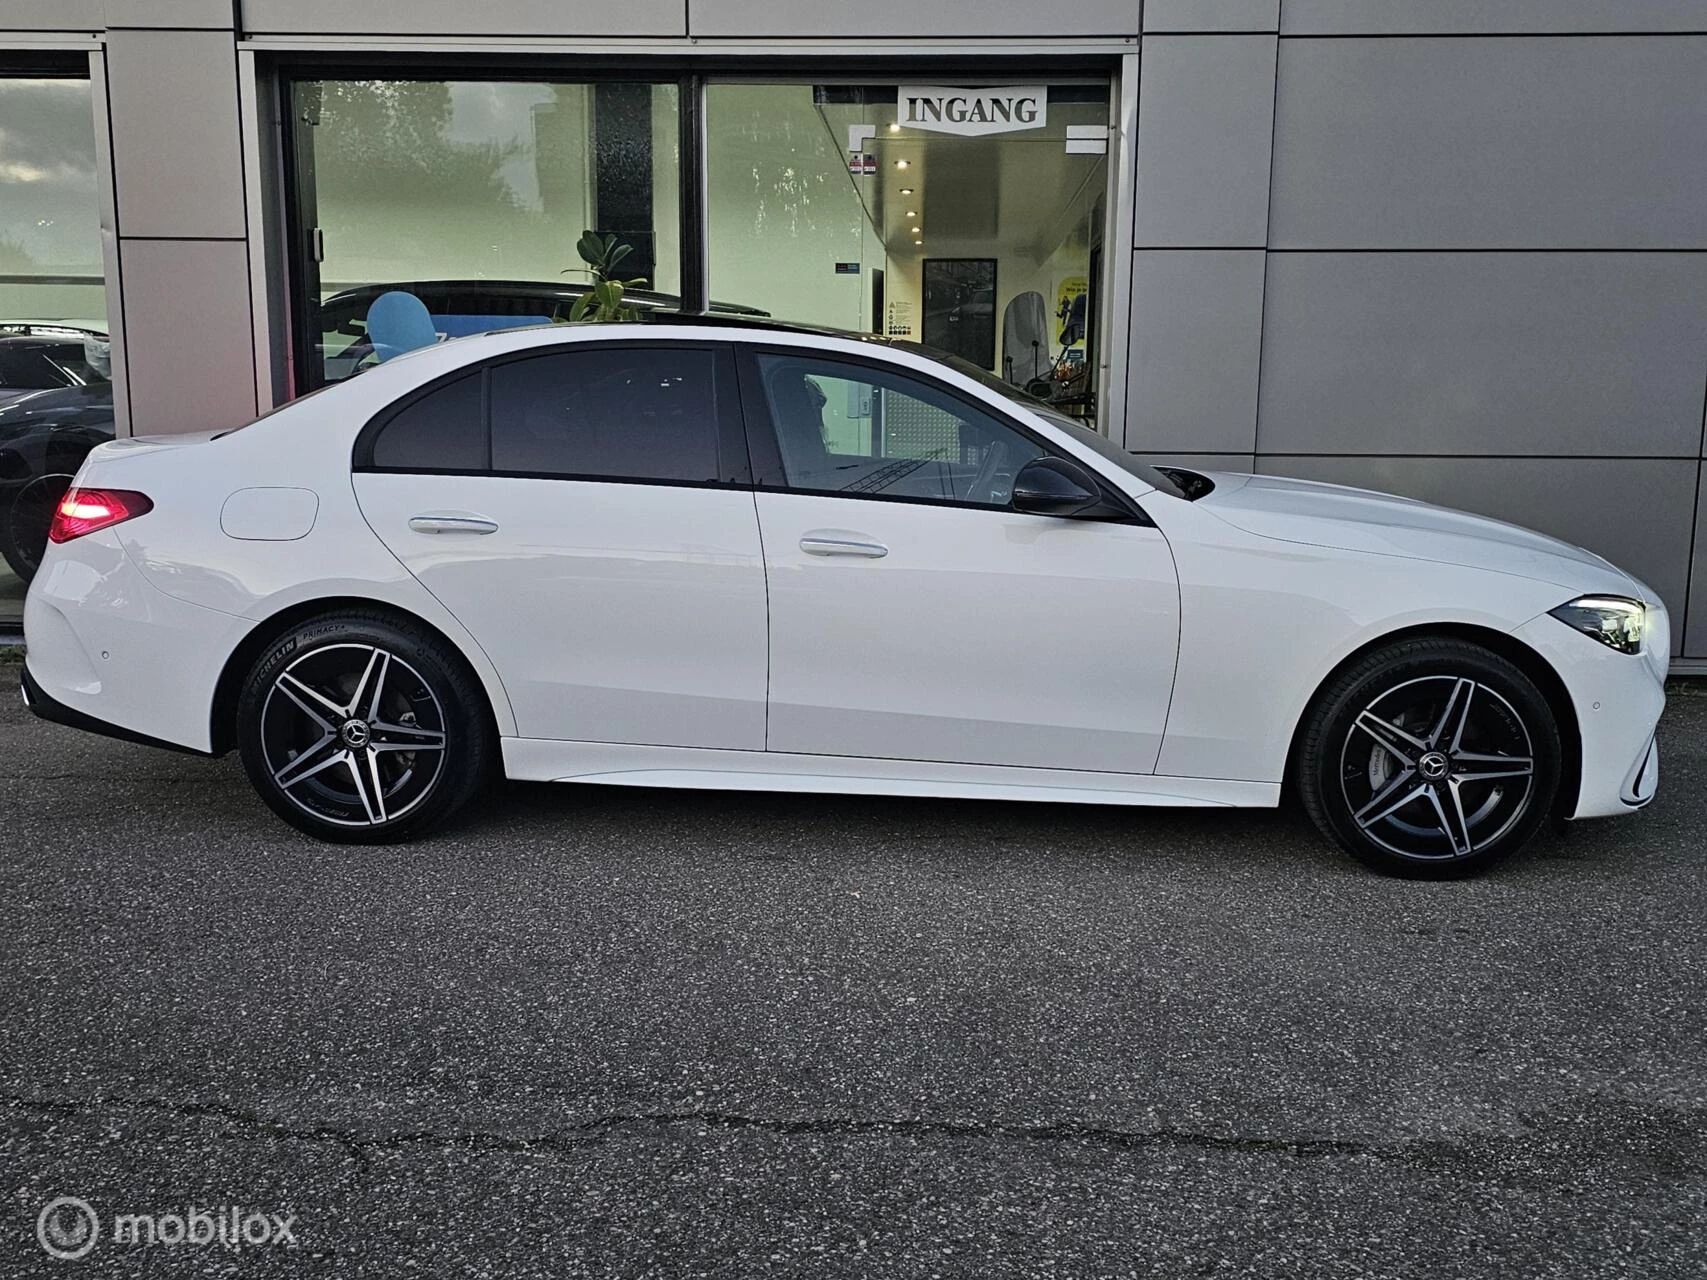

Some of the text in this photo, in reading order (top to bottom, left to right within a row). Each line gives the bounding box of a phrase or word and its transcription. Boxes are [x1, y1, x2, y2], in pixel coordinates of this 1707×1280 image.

[906, 97, 1038, 123] INGANG
[250, 624, 340, 694] MICHELIN PRIMACY
